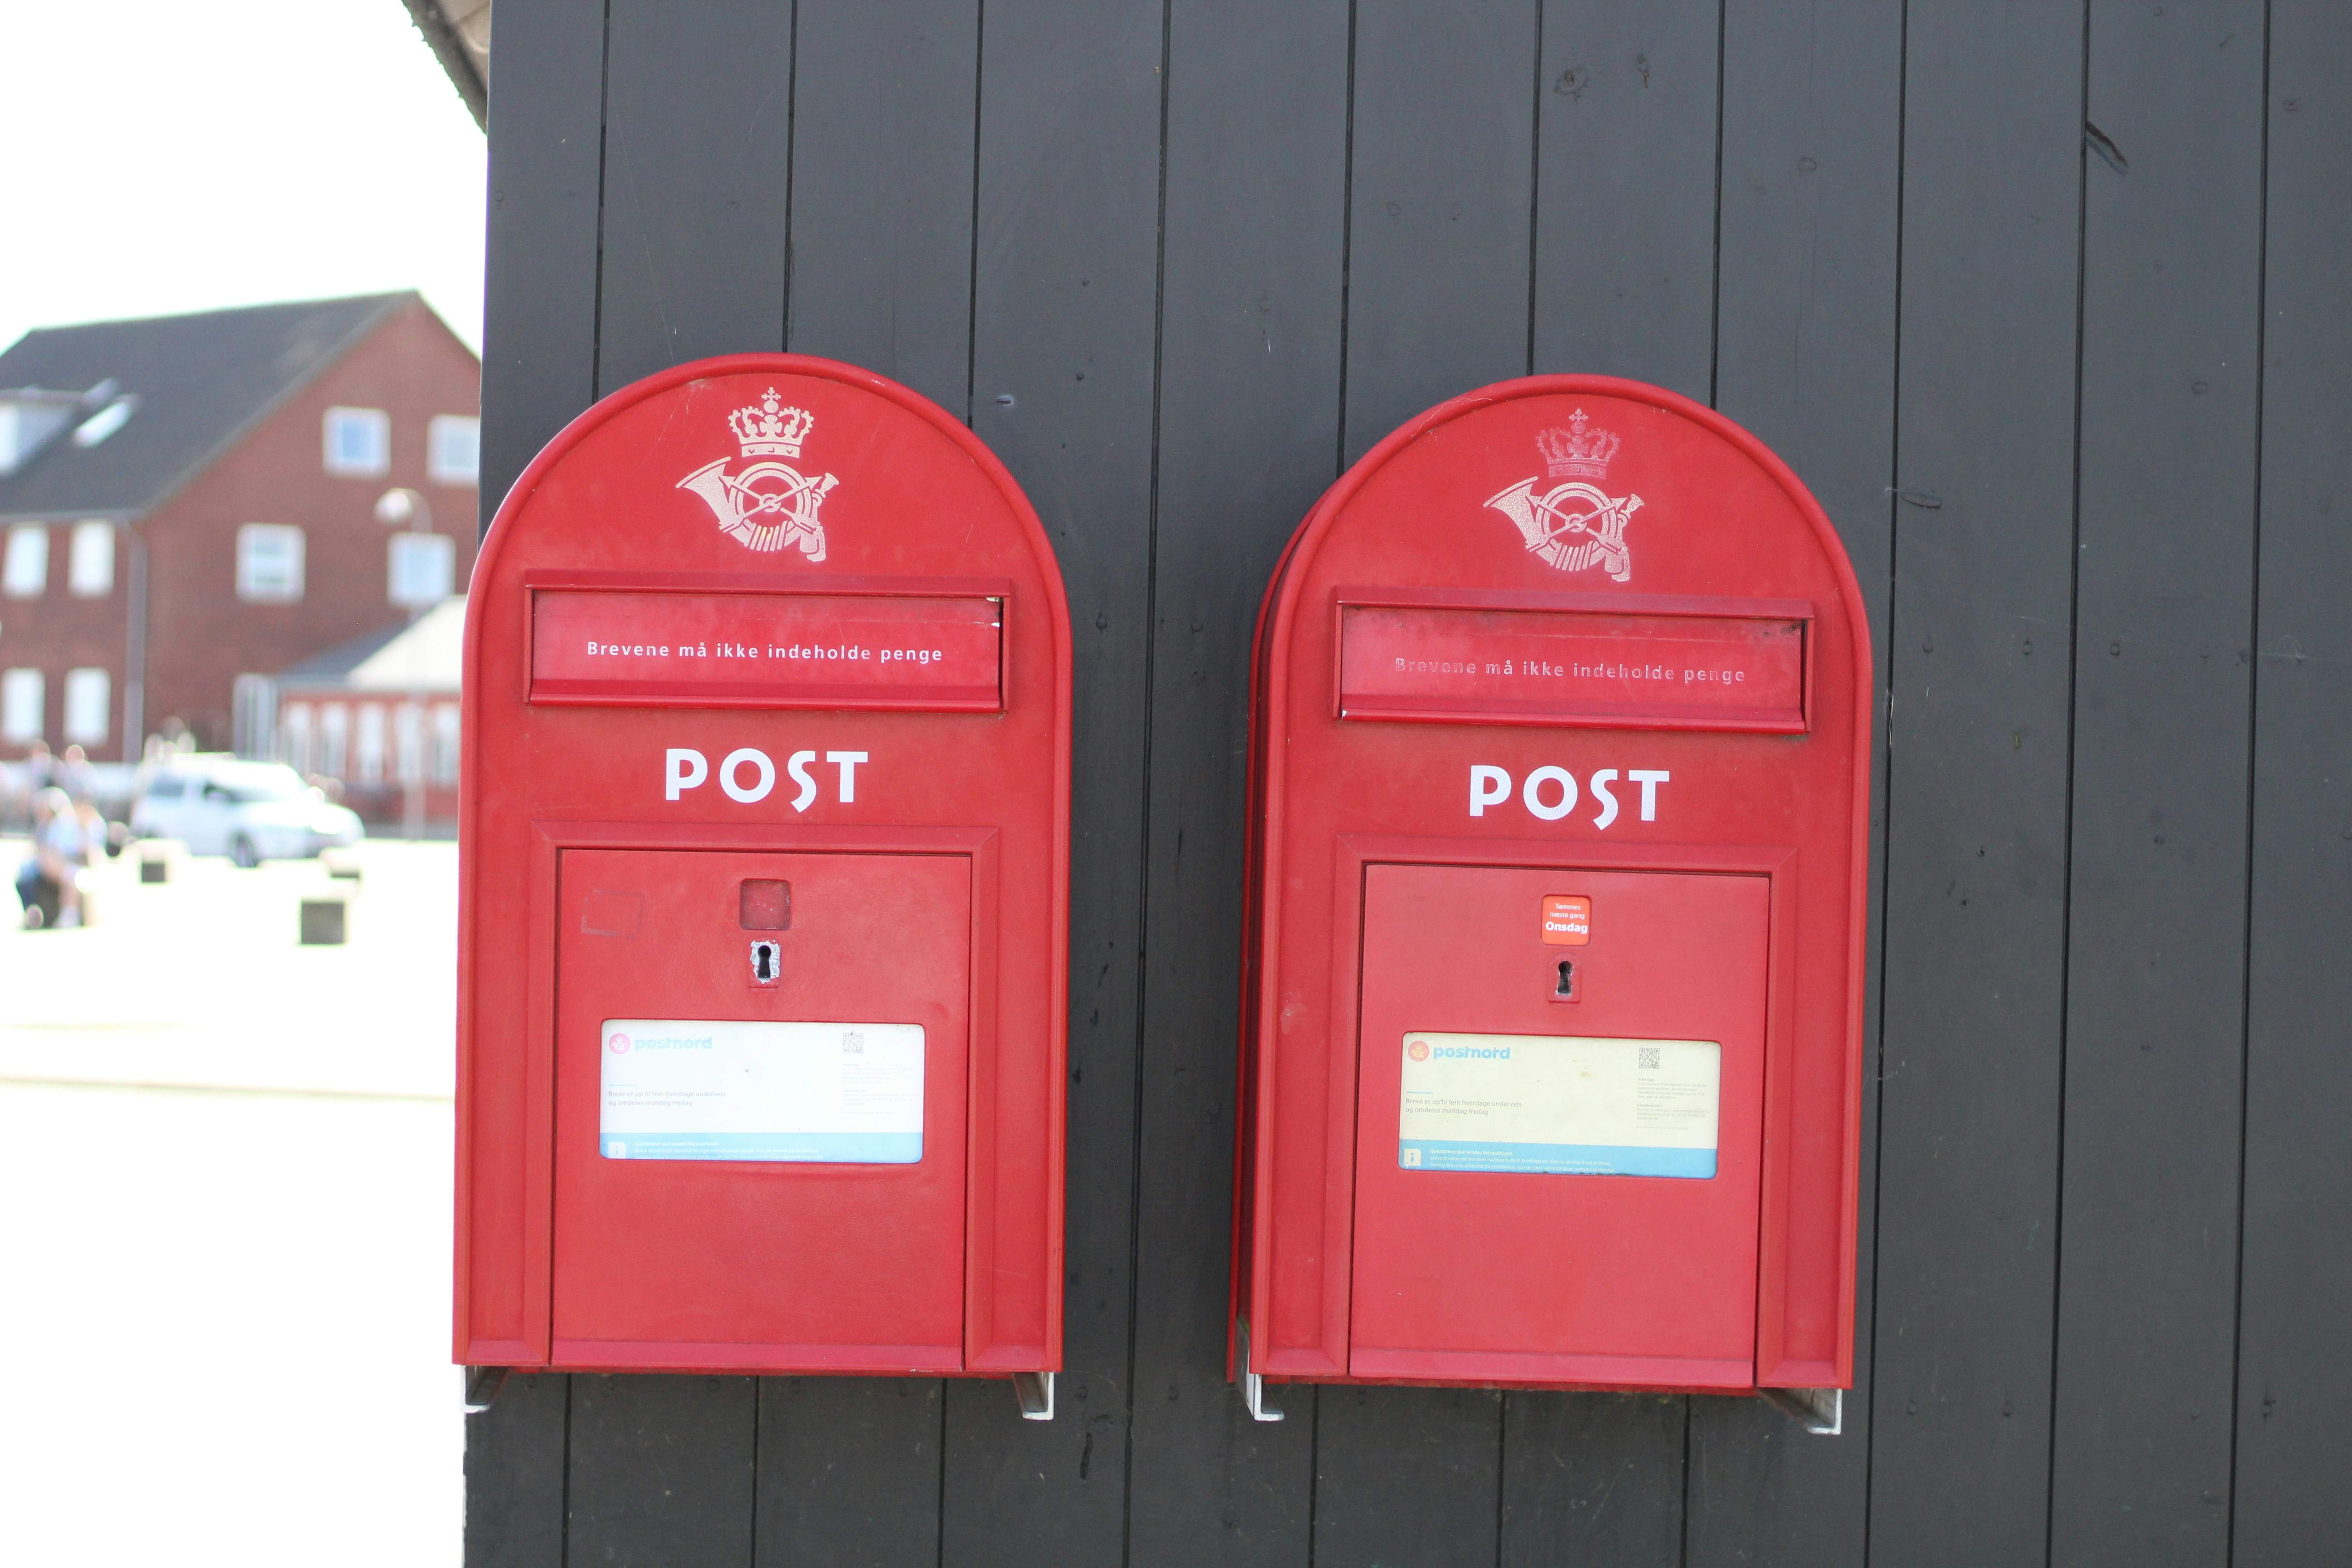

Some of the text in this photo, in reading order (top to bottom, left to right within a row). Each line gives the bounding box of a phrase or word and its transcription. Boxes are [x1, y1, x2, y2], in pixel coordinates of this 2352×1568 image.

[587, 642, 943, 664] Brevene må ikke indeholde penge
[1395, 657, 1746, 685] Brevene må ikke indeholde penge
[665, 748, 869, 813] POST
[1469, 765, 1671, 831] POST
[1545, 921, 1588, 934] Onsdag
[635, 1036, 713, 1050] postnord
[1433, 1045, 1511, 1060] postnord
